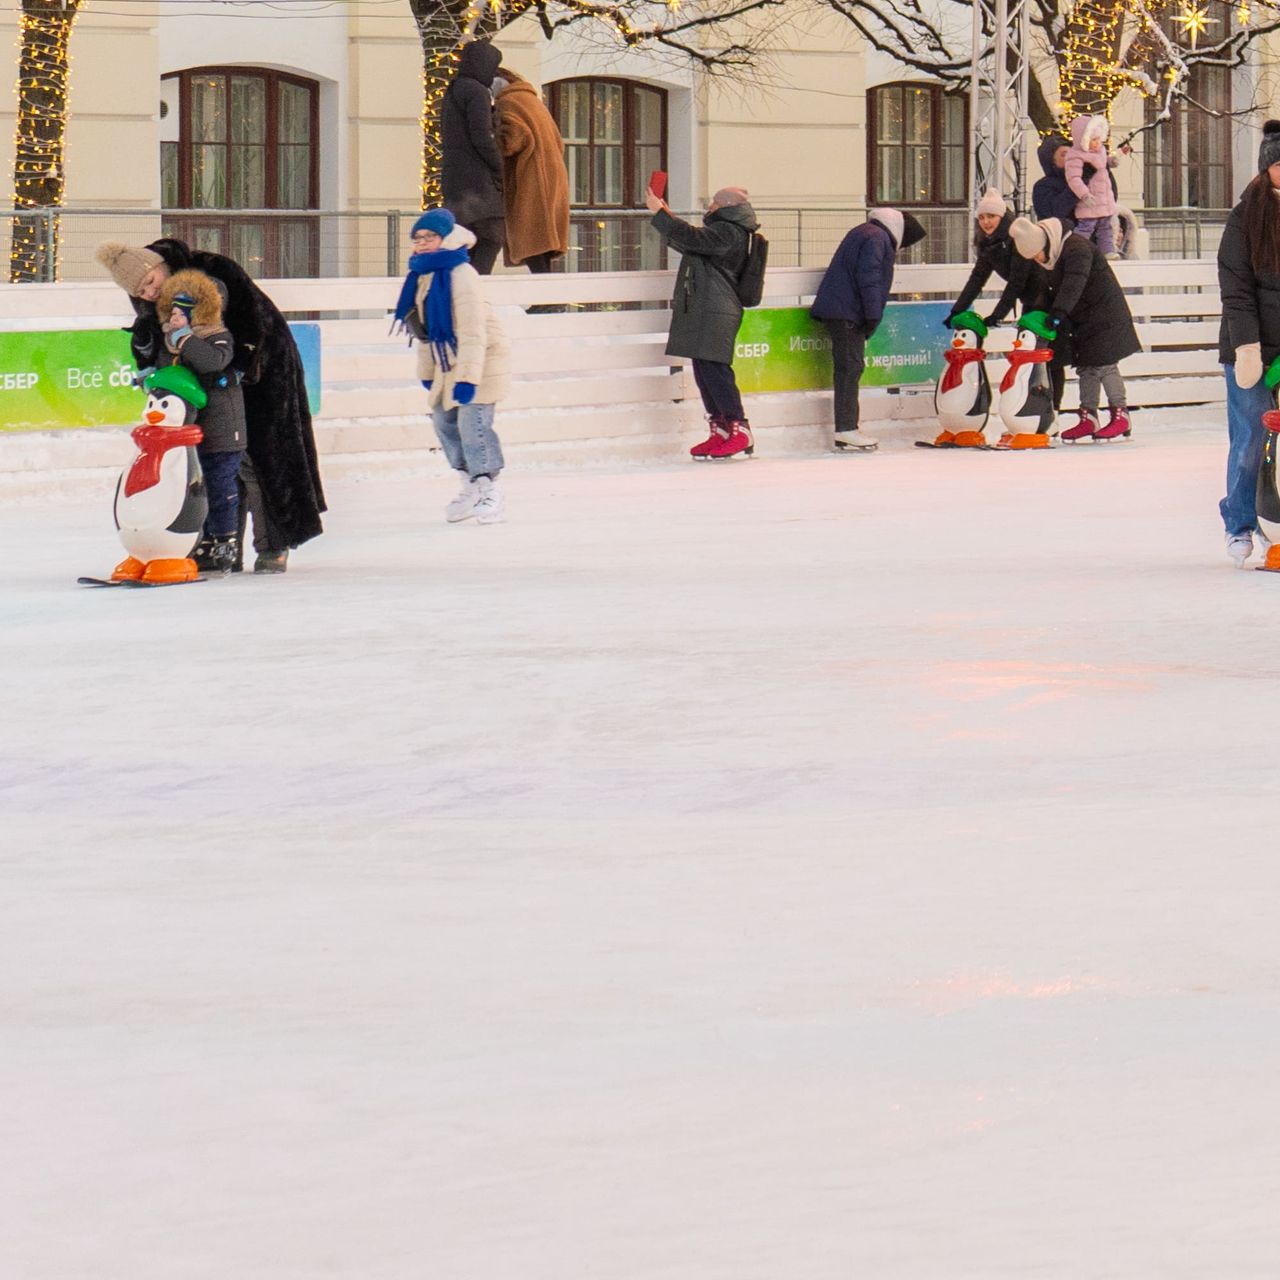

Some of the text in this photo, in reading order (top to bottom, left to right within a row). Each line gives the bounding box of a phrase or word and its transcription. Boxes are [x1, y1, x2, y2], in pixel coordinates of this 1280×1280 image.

[735, 343, 770, 358] СБЕР
[871, 349, 932, 367] желаний!
[67, 365, 103, 389] Всё
